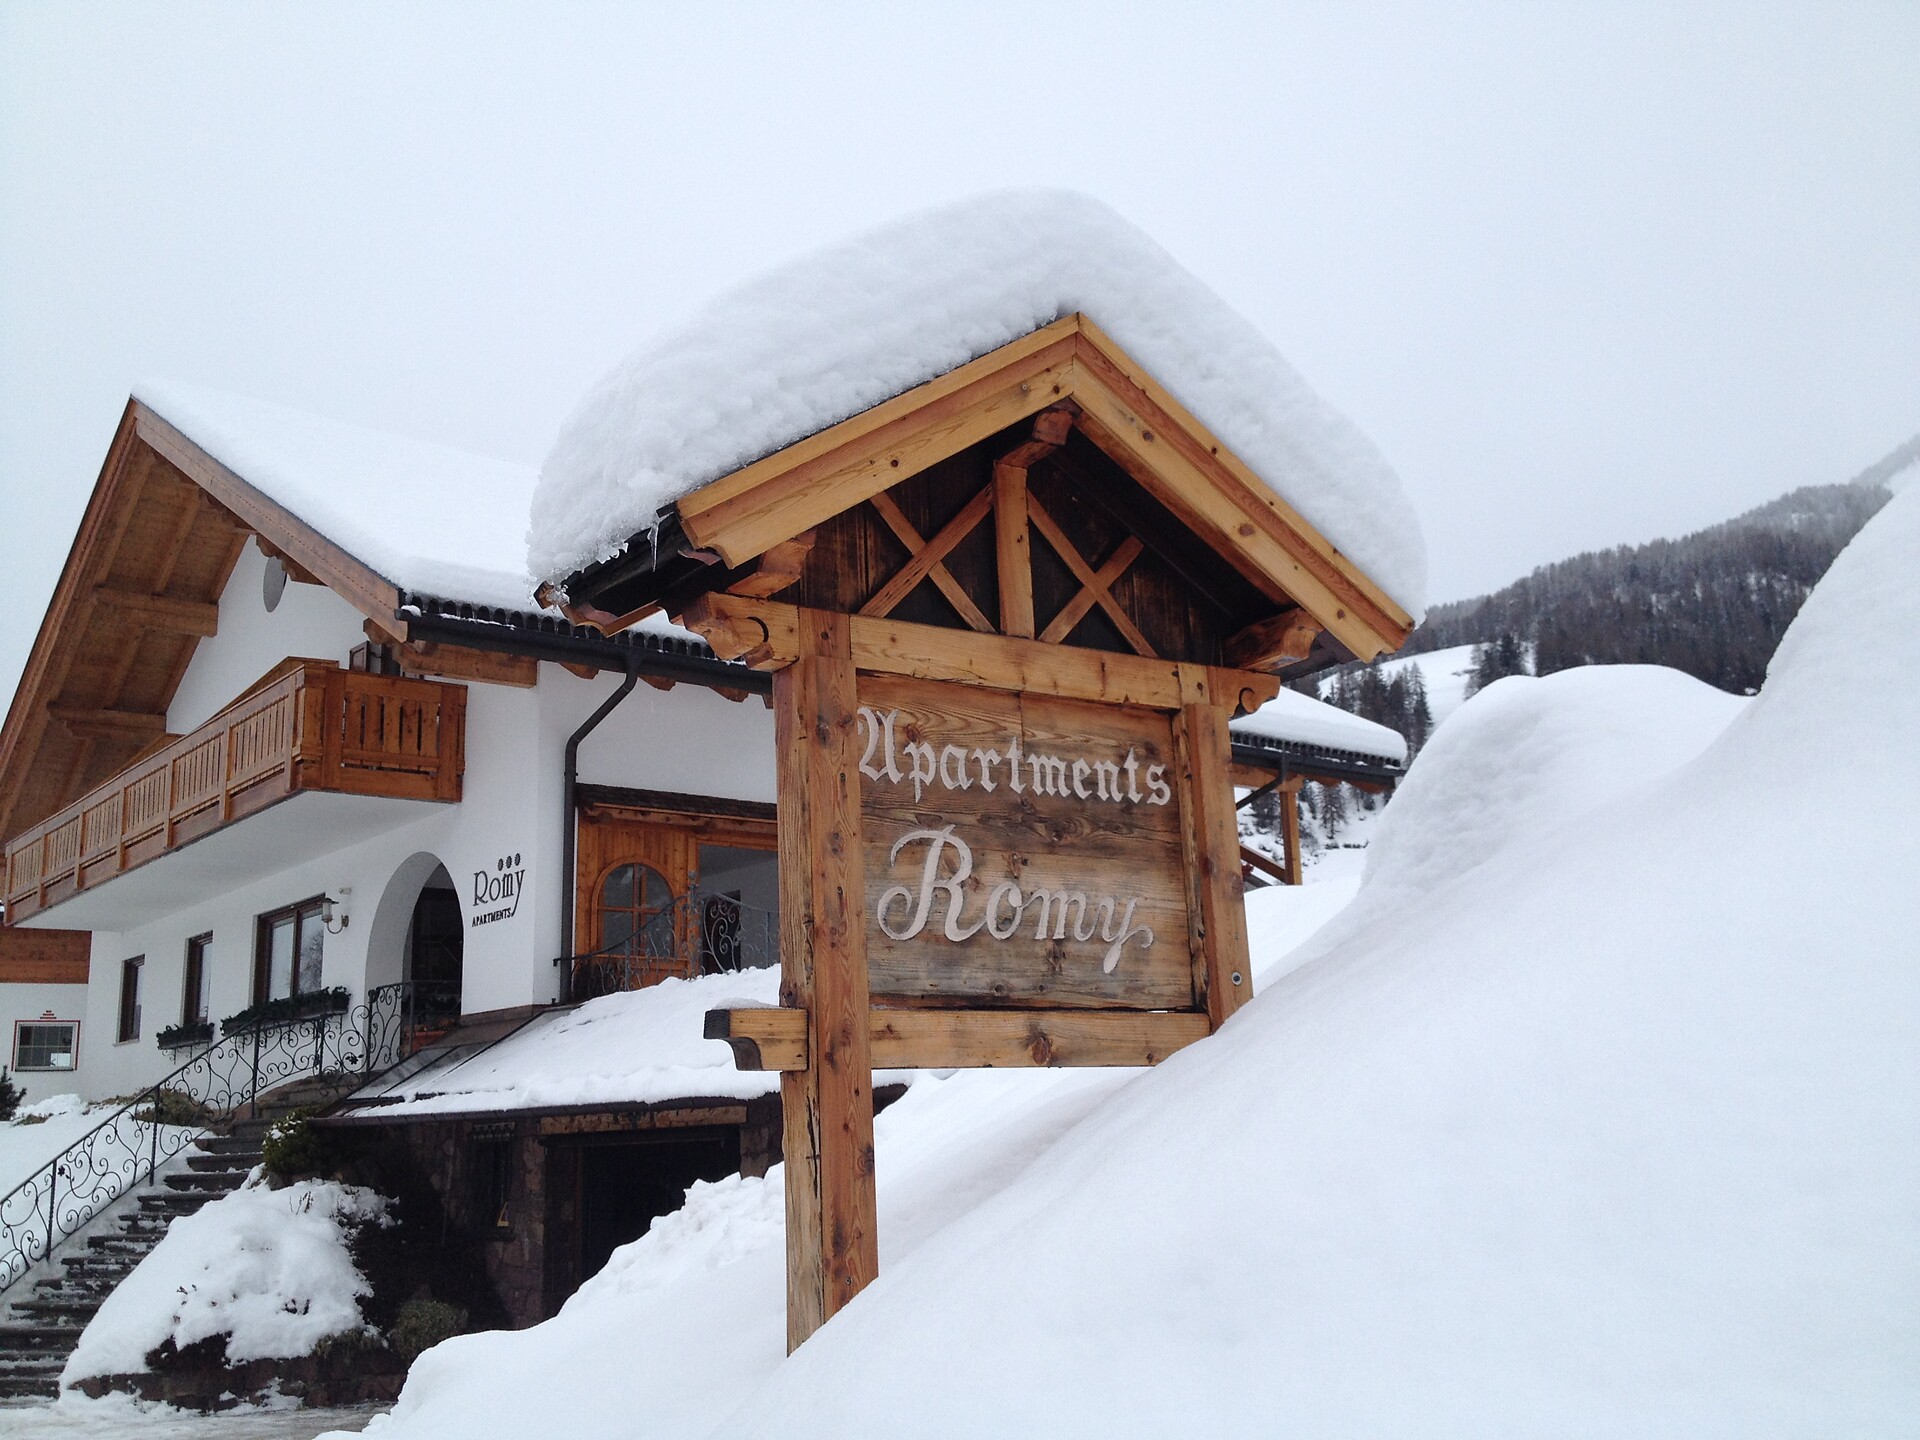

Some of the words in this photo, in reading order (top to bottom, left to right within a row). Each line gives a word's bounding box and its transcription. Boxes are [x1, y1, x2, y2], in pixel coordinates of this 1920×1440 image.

[857, 706, 1171, 806] Apartments
[471, 907, 511, 927] APARTMENTS
[473, 869, 525, 917] Romy
[877, 824, 1154, 974] Romy
